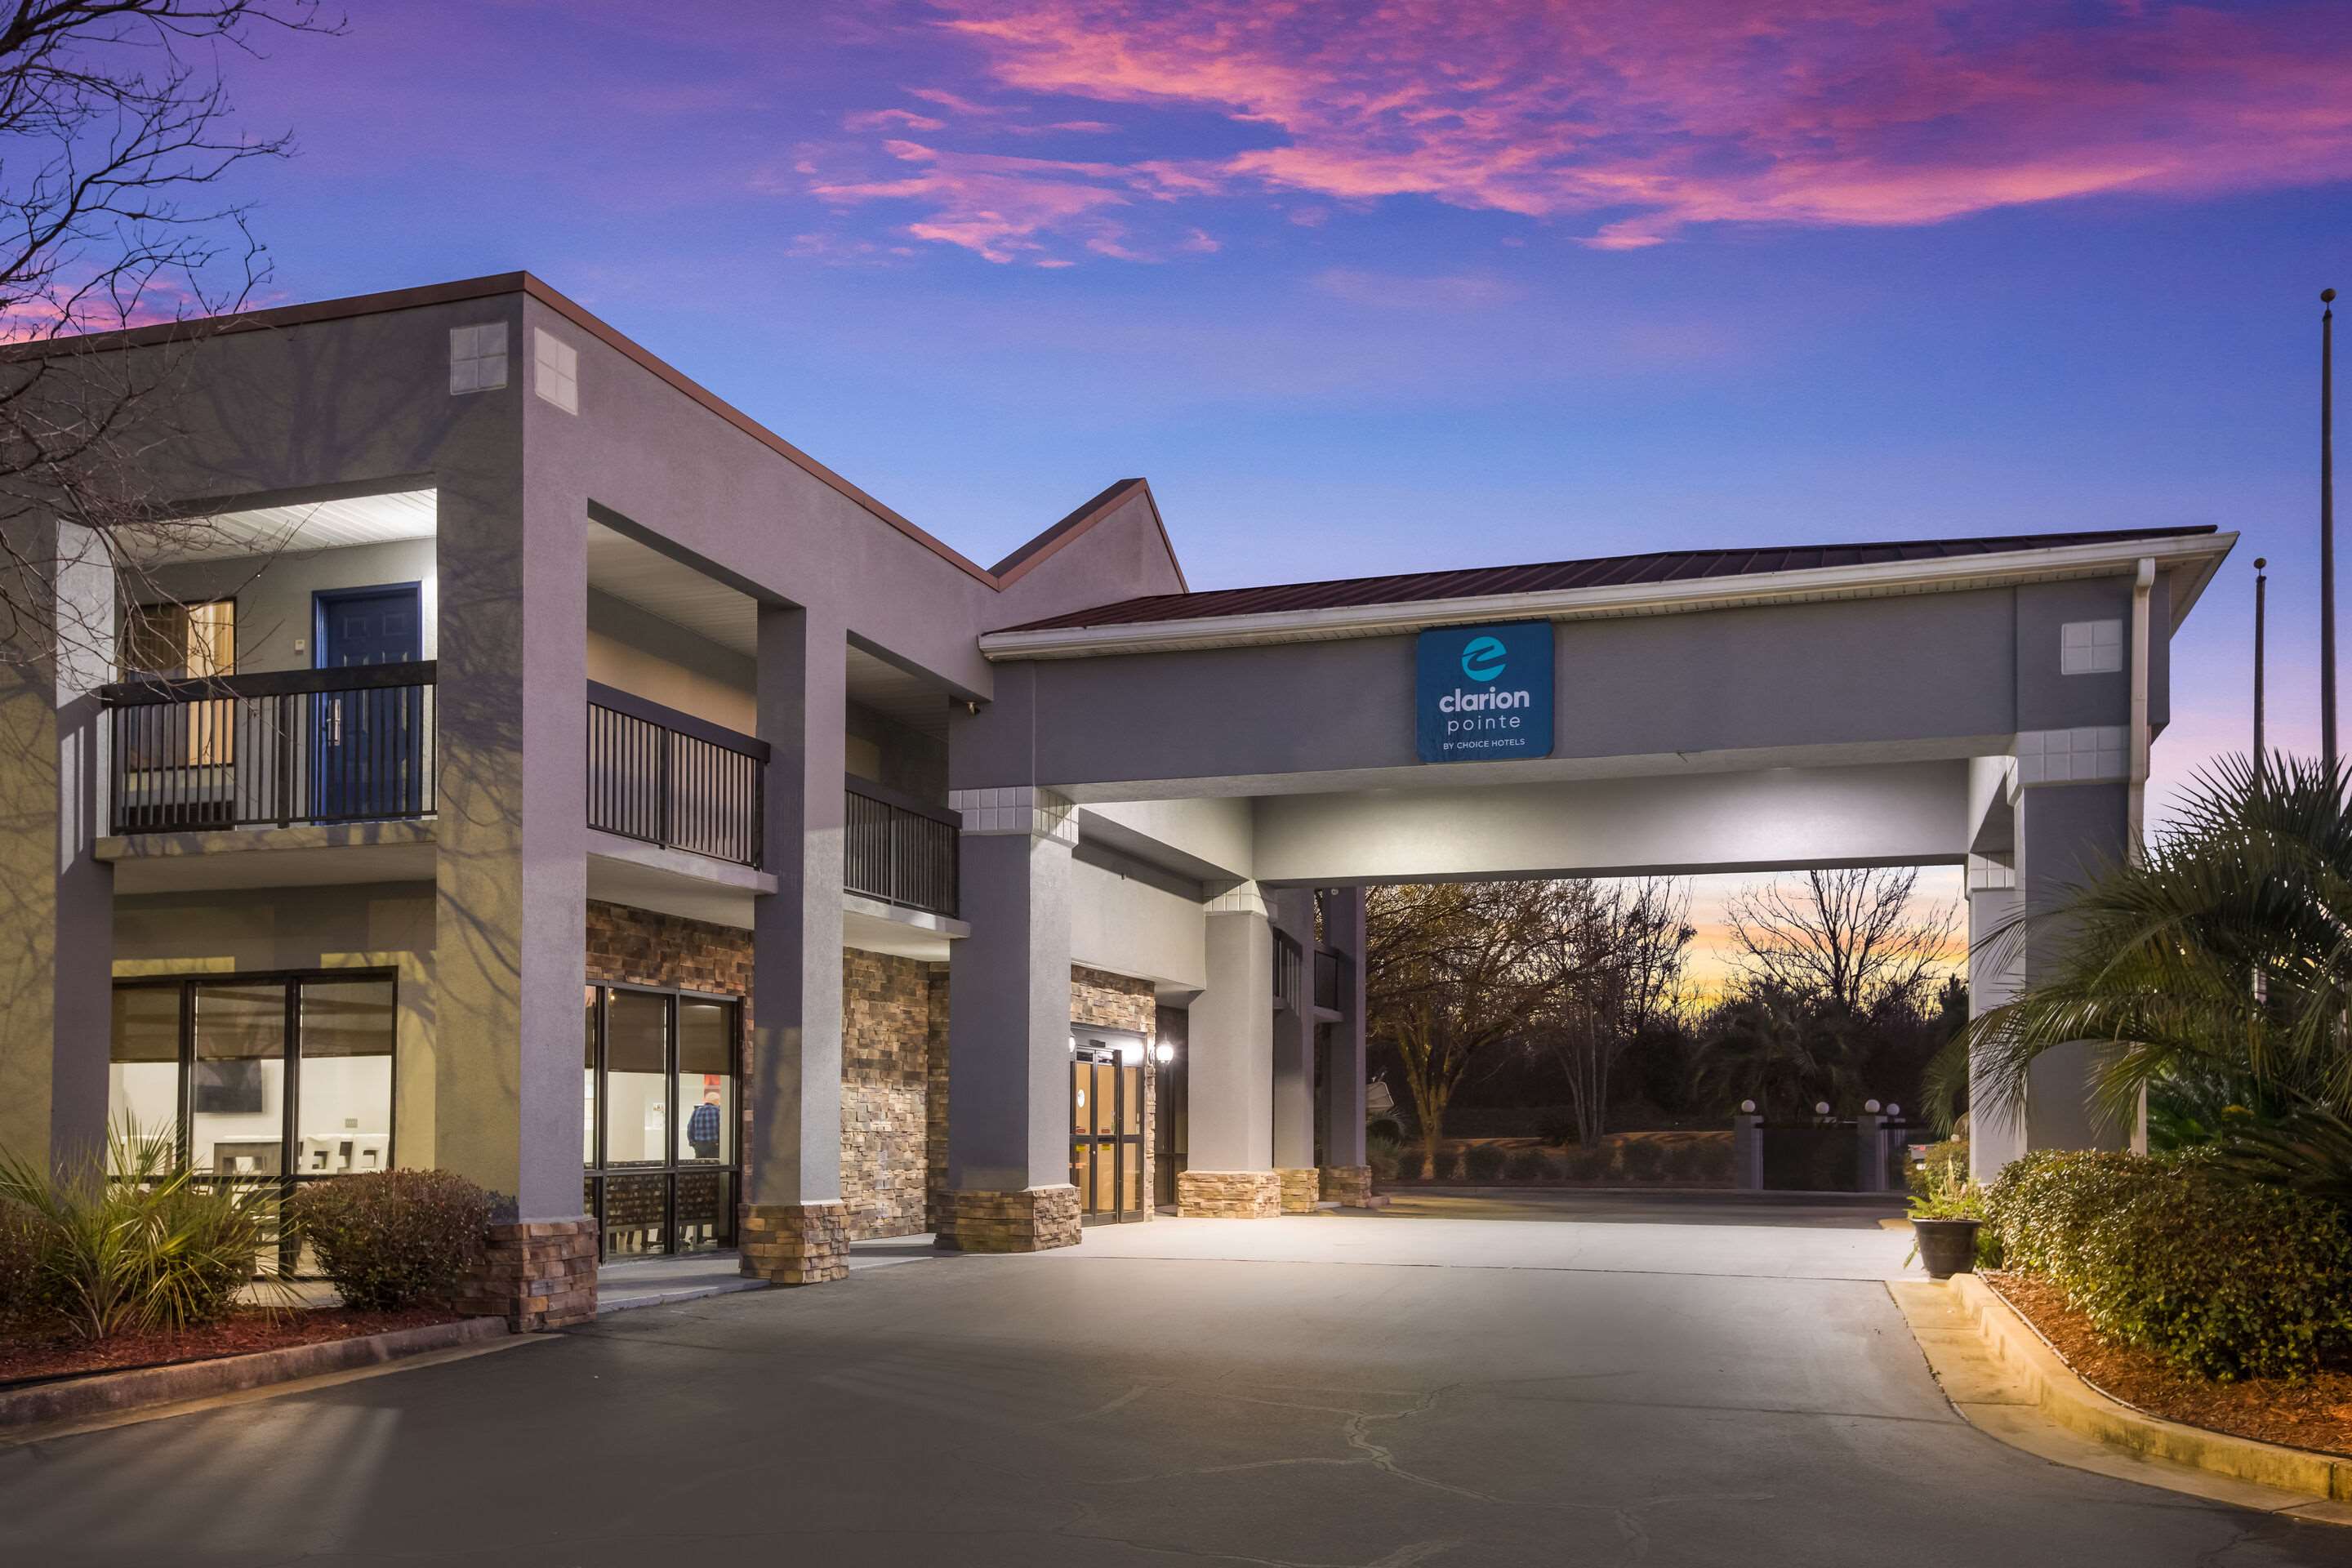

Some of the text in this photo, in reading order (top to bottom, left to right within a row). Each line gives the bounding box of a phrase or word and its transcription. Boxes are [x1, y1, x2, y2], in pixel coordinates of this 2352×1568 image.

[1439, 686, 1530, 713] clarion
[1448, 715, 1521, 735] pointe
[1456, 740, 1490, 749] CHOICE
[1491, 738, 1526, 746] HOTELS
